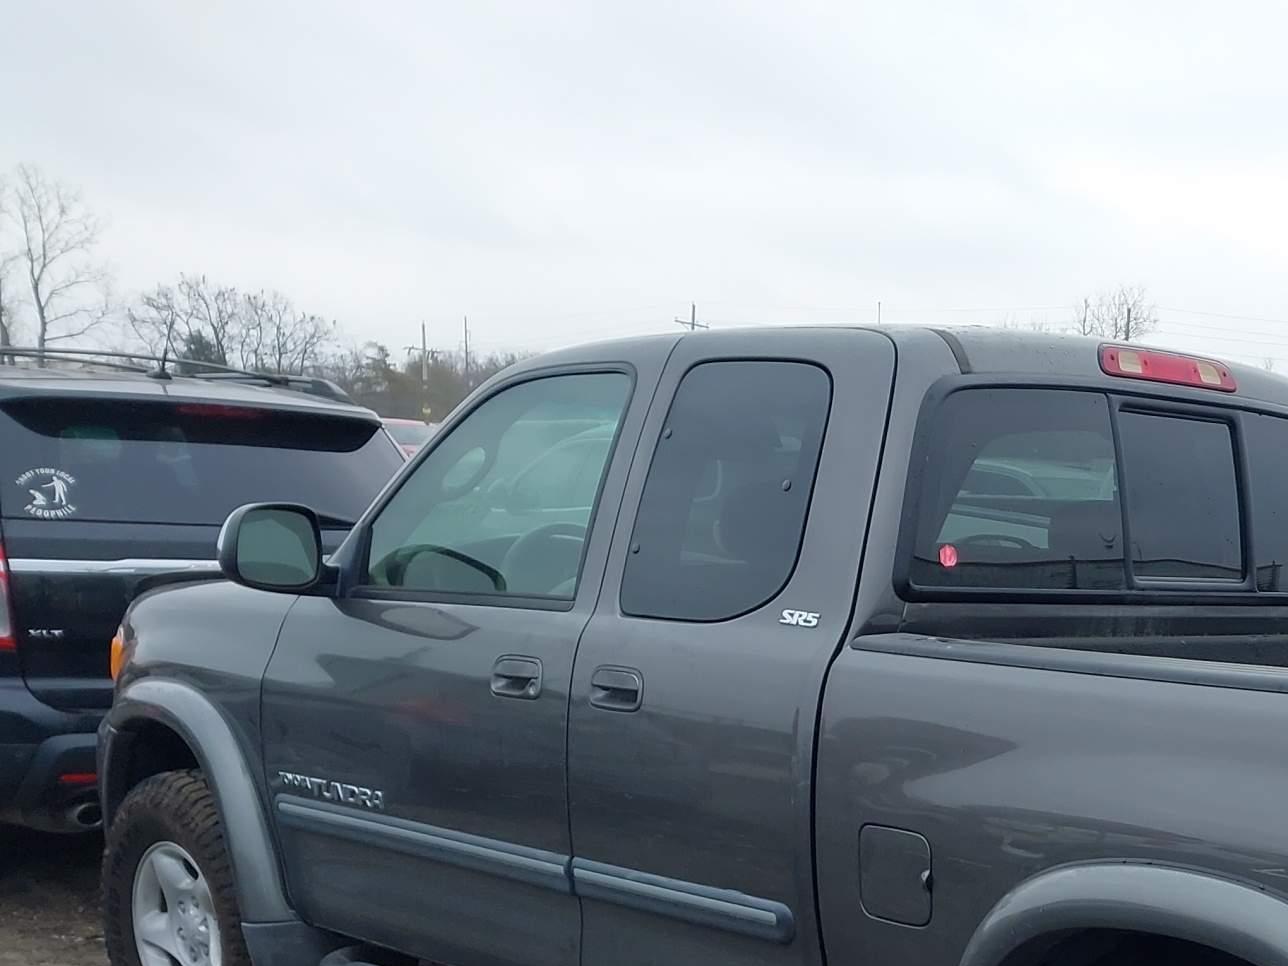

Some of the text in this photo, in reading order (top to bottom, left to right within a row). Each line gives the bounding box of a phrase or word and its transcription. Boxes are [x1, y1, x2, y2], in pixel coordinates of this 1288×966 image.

[779, 609, 820, 628] SR5
[28, 629, 64, 638] XLT
[309, 777, 384, 809] TUNDRA
